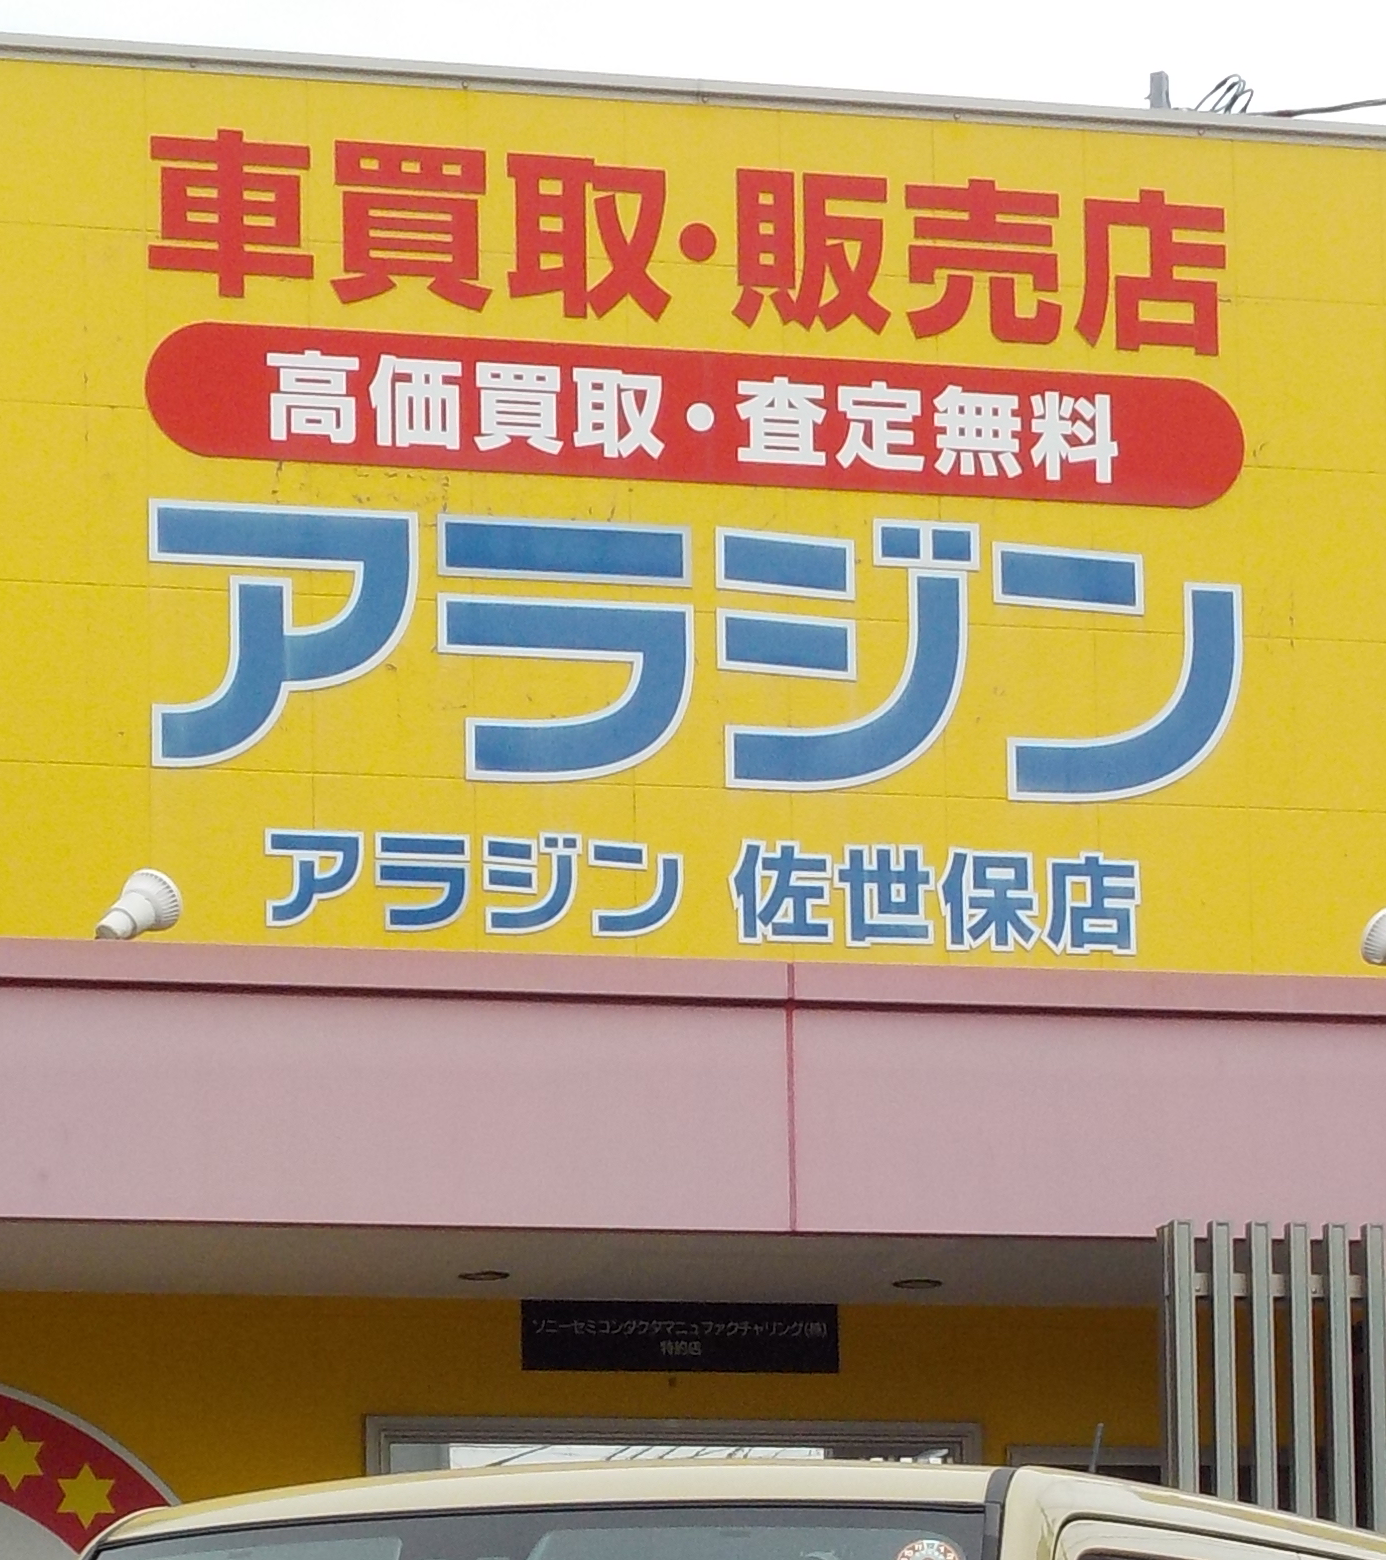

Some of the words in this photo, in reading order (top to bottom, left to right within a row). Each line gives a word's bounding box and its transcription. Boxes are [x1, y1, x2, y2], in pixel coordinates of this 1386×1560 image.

[147, 130, 1228, 356] 車買取・販売店
[265, 350, 1119, 484] 高価買取・査定無料
[149, 498, 1243, 802] アラジン
[264, 828, 685, 938] アラジン
[730, 839, 1139, 957] 佐世保店
